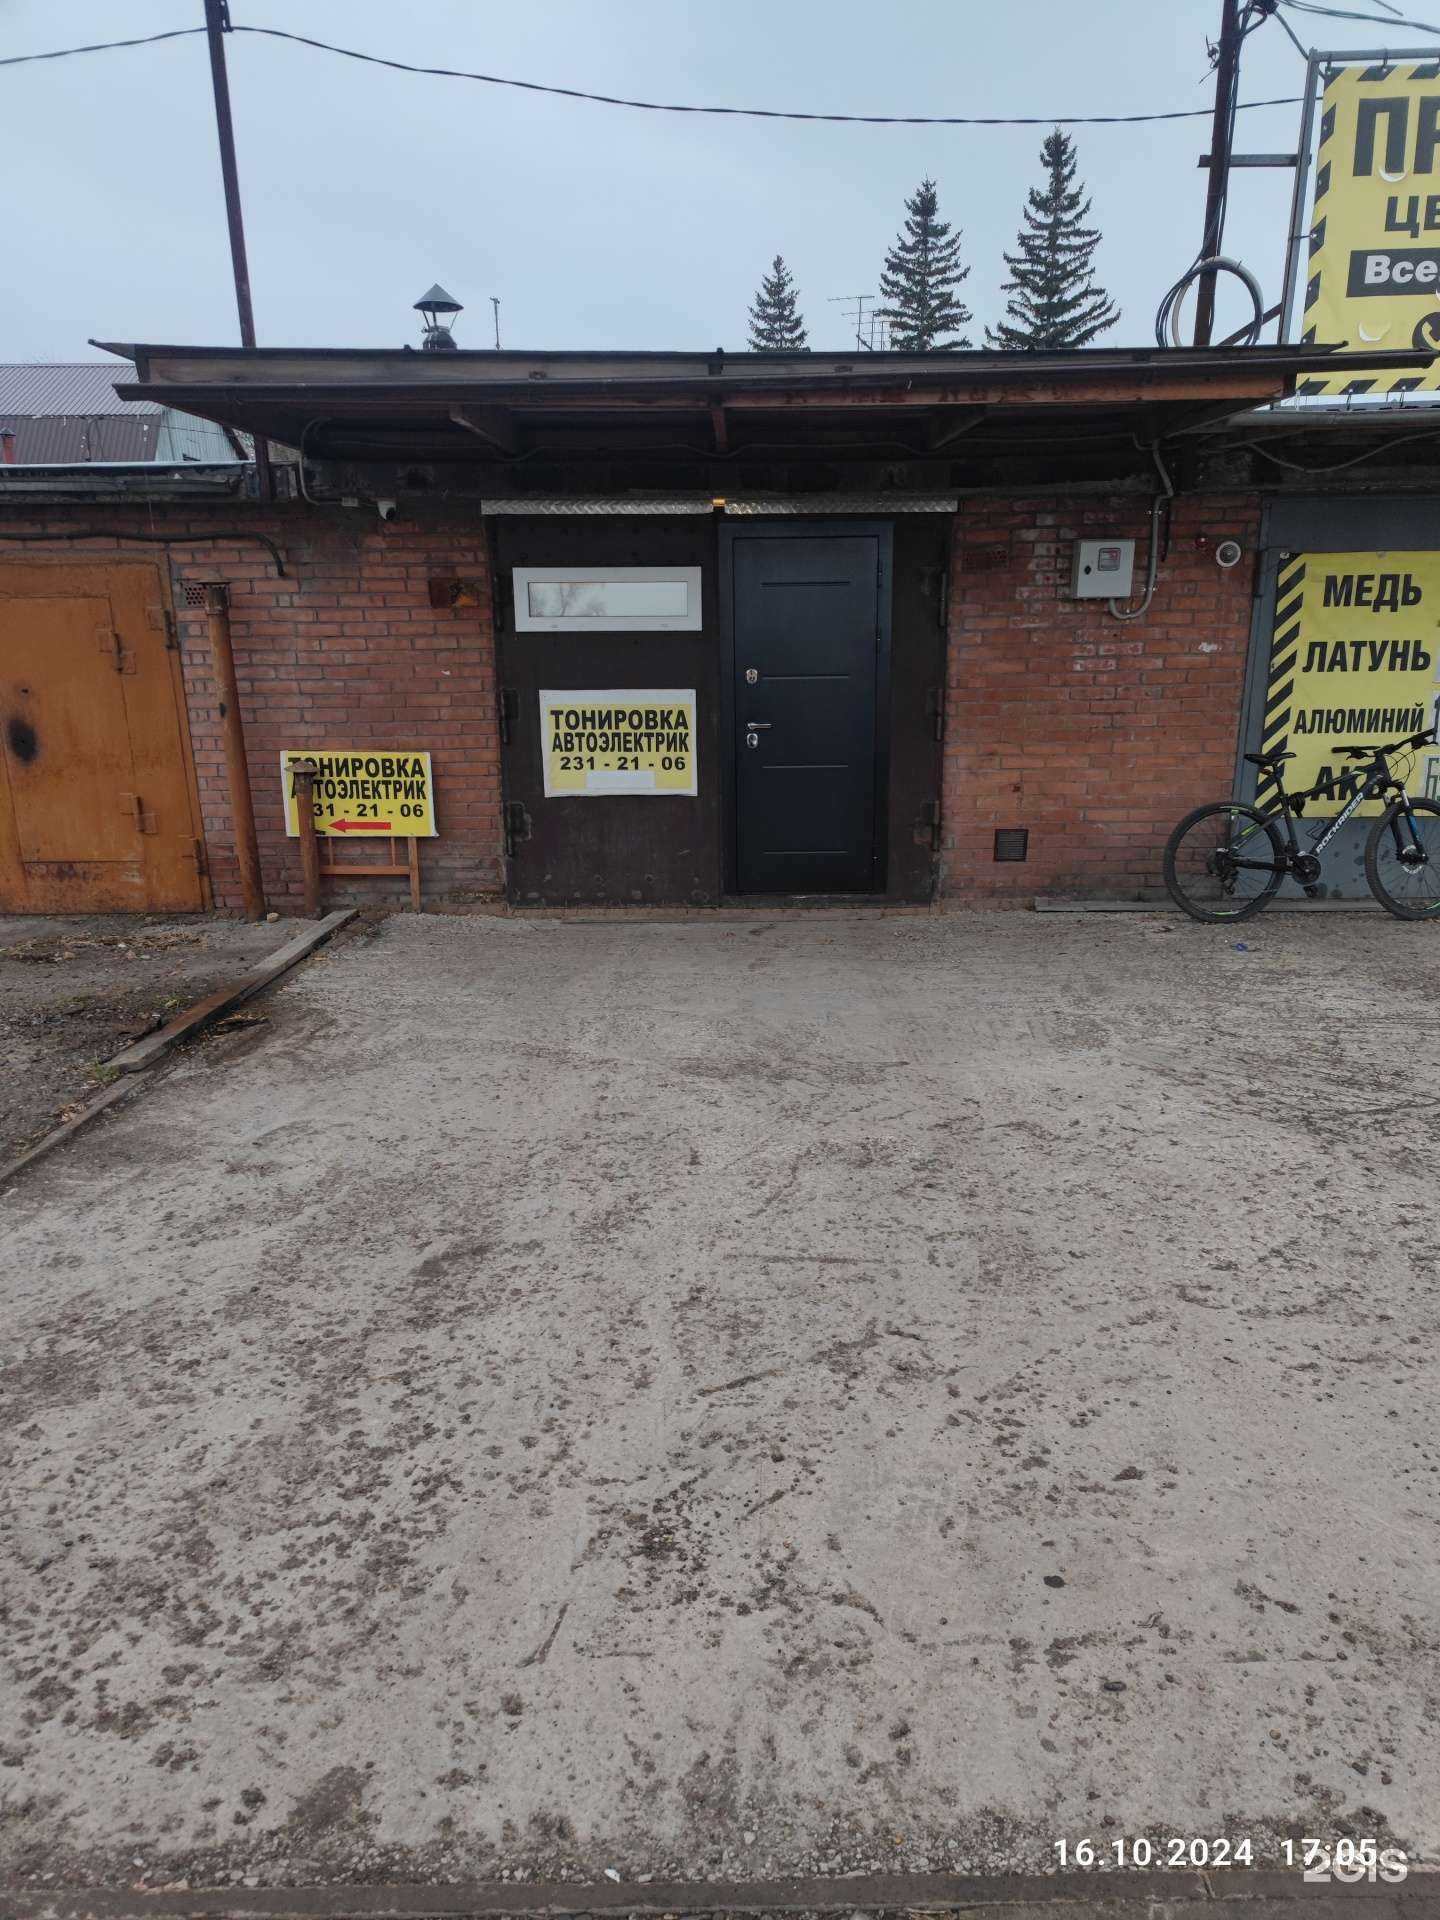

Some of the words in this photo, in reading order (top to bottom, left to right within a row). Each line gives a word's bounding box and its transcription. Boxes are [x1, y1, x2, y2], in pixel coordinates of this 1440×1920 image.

[1323, 574, 1422, 612] МЕДЬ
[1302, 640, 1431, 673] ЛАТУНЬ
[550, 709, 689, 730] ТОНИРОВКА
[1293, 702, 1425, 734] АЛЮМИНИЙ
[552, 732, 690, 752] АВТОЭЛЕКТРИК
[291, 780, 427, 800] ТОЭЛЕКТРИК
[1310, 766, 1383, 800] АК
[1315, 792, 1364, 853] ROCKRIDER
